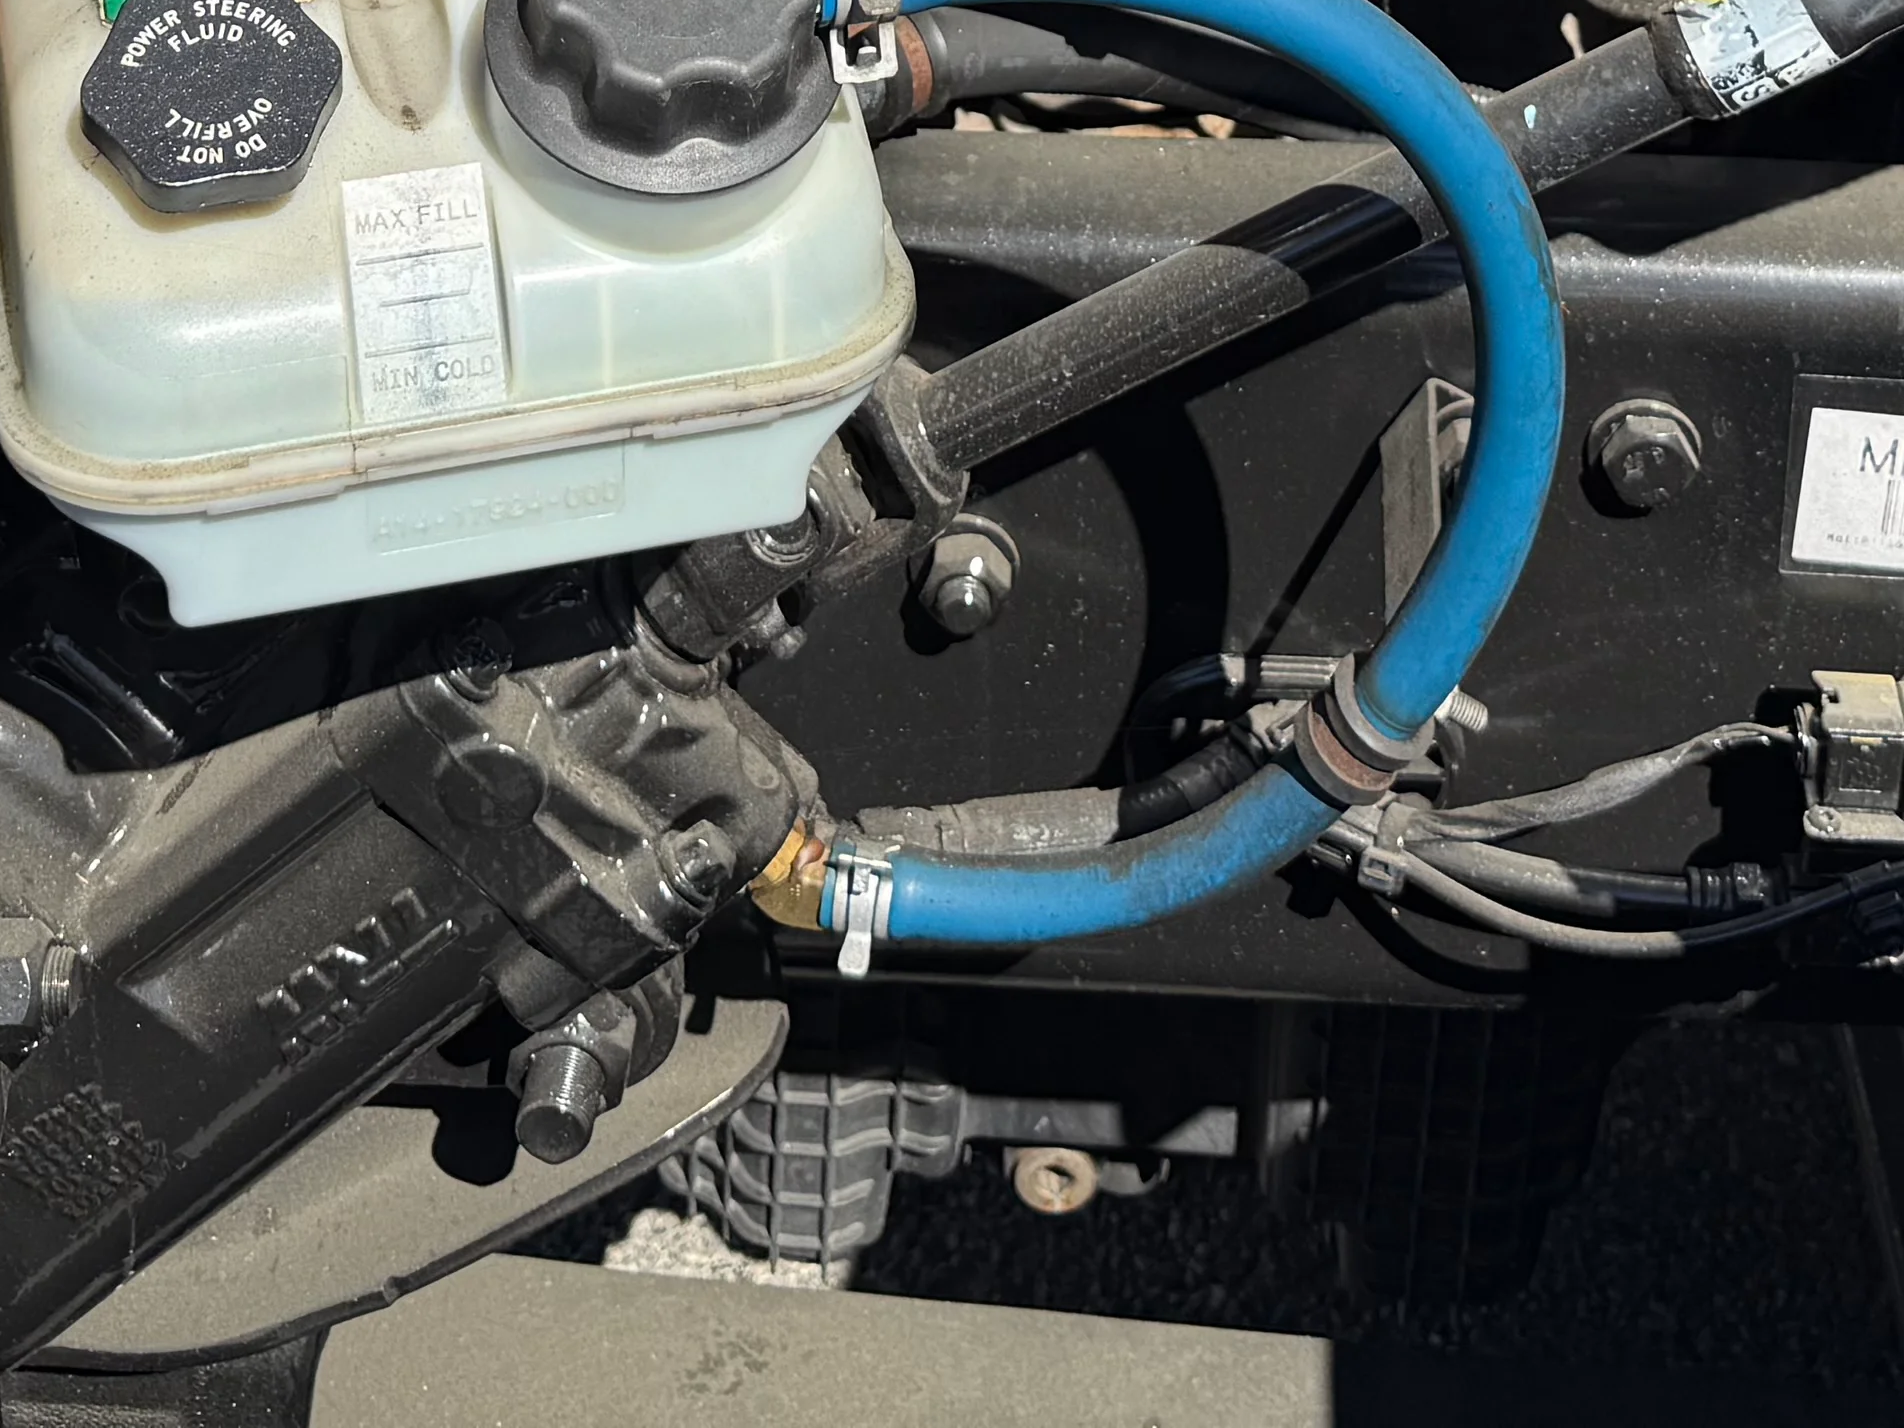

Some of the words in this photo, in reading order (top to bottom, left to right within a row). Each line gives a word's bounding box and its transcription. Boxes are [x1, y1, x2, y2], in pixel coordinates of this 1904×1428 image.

[121, 8, 182, 69] POWER
[168, 22, 244, 53] FLUID
[163, 97, 273, 141] OVERFILL
[176, 144, 224, 165] NOT
[235, 132, 267, 161] DO
[355, 208, 407, 235] MAX
[417, 199, 478, 226] FILL
[371, 366, 419, 393] MIN
[433, 354, 496, 383] COLD
